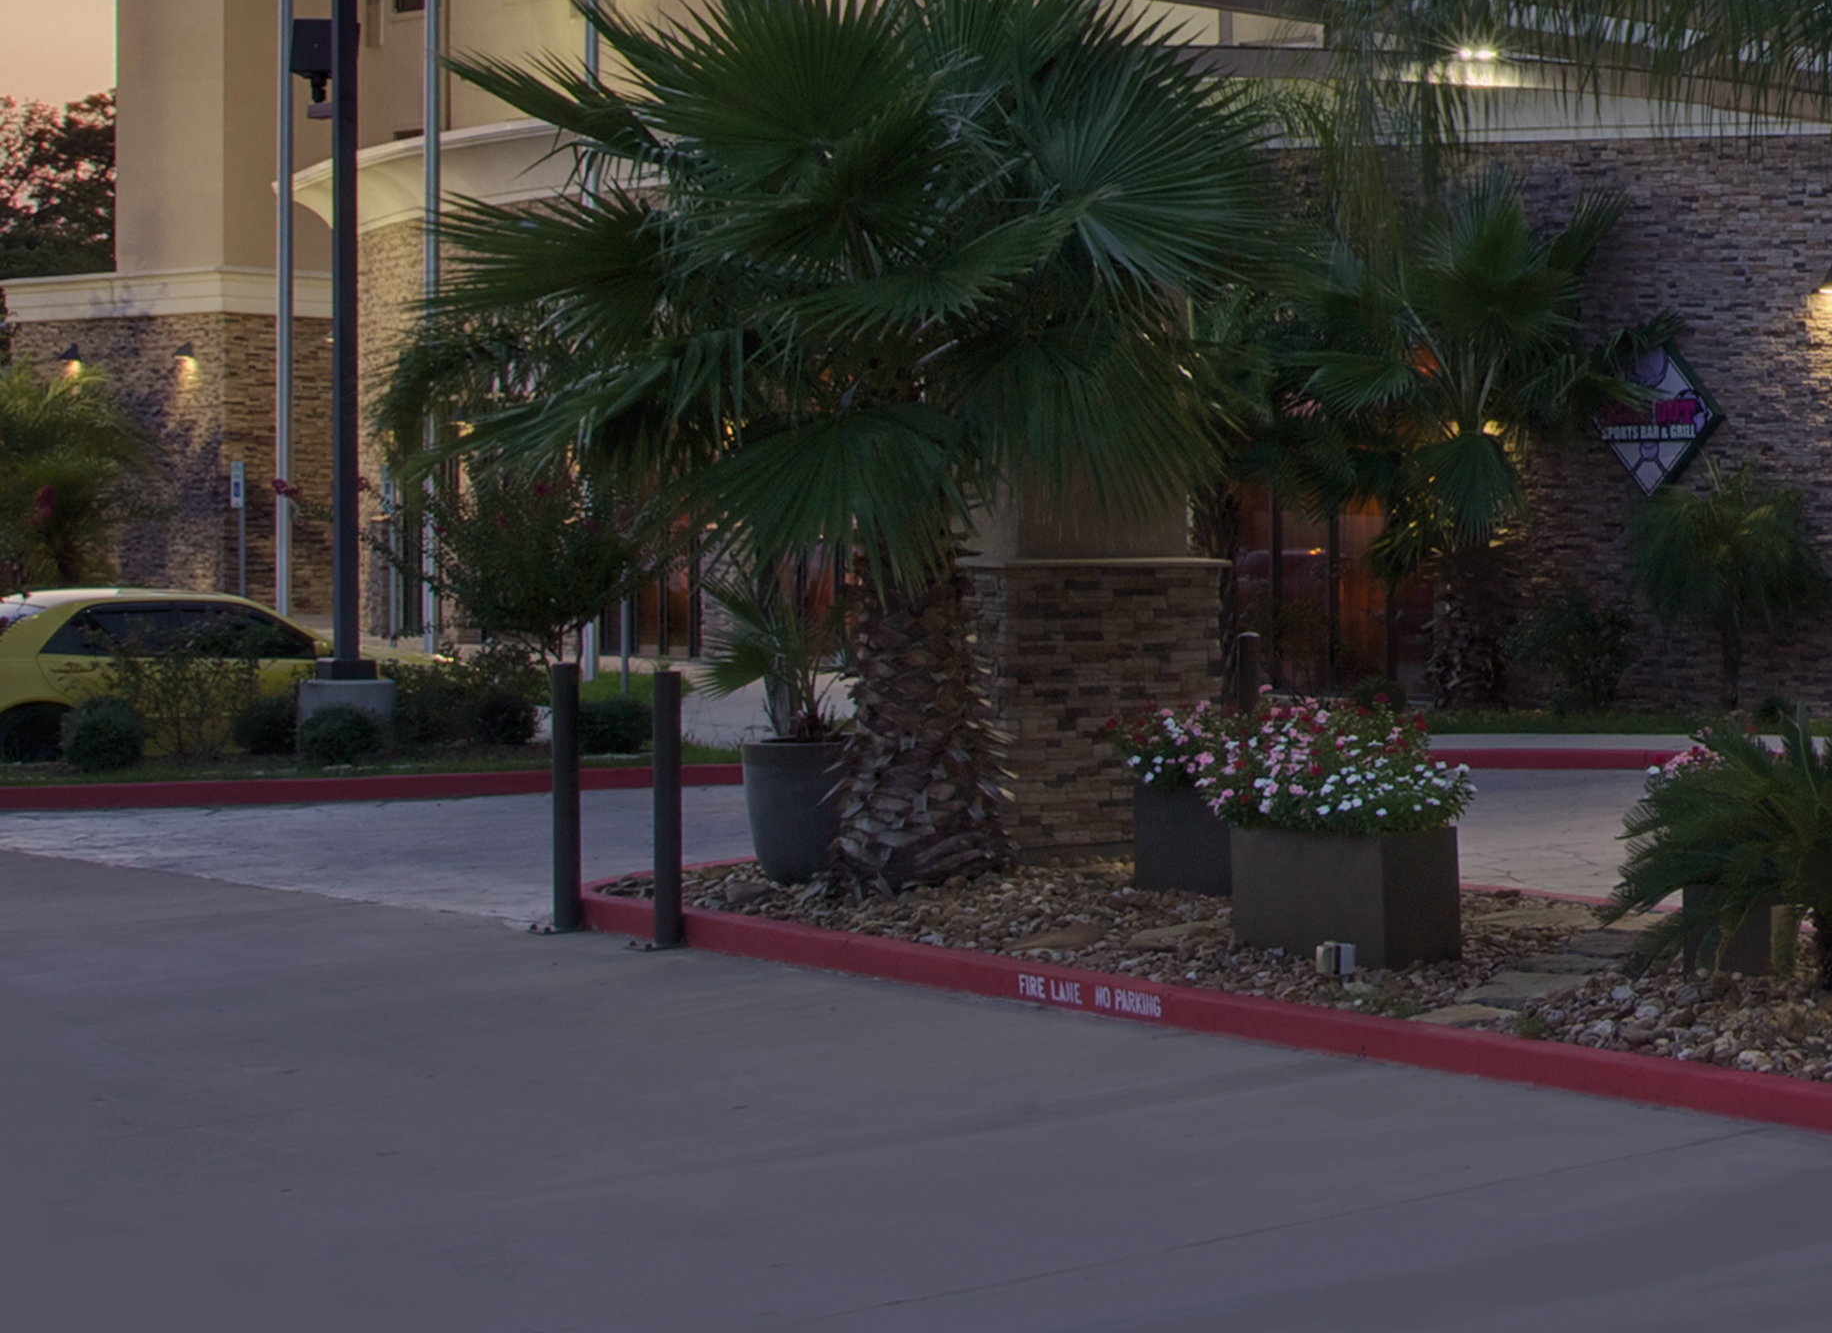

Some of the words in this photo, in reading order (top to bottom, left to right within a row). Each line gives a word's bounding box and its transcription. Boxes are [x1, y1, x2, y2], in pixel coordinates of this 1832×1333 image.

[1655, 400, 1696, 424] OUT
[1601, 424, 1639, 440] SPORTS
[1640, 424, 1660, 439] BAR
[1669, 423, 1696, 439] GRILL
[1017, 973, 1046, 999] FIRE
[1051, 980, 1083, 1005] LANE
[1094, 985, 1111, 1009] NO
[1114, 989, 1162, 1018] PARKING
